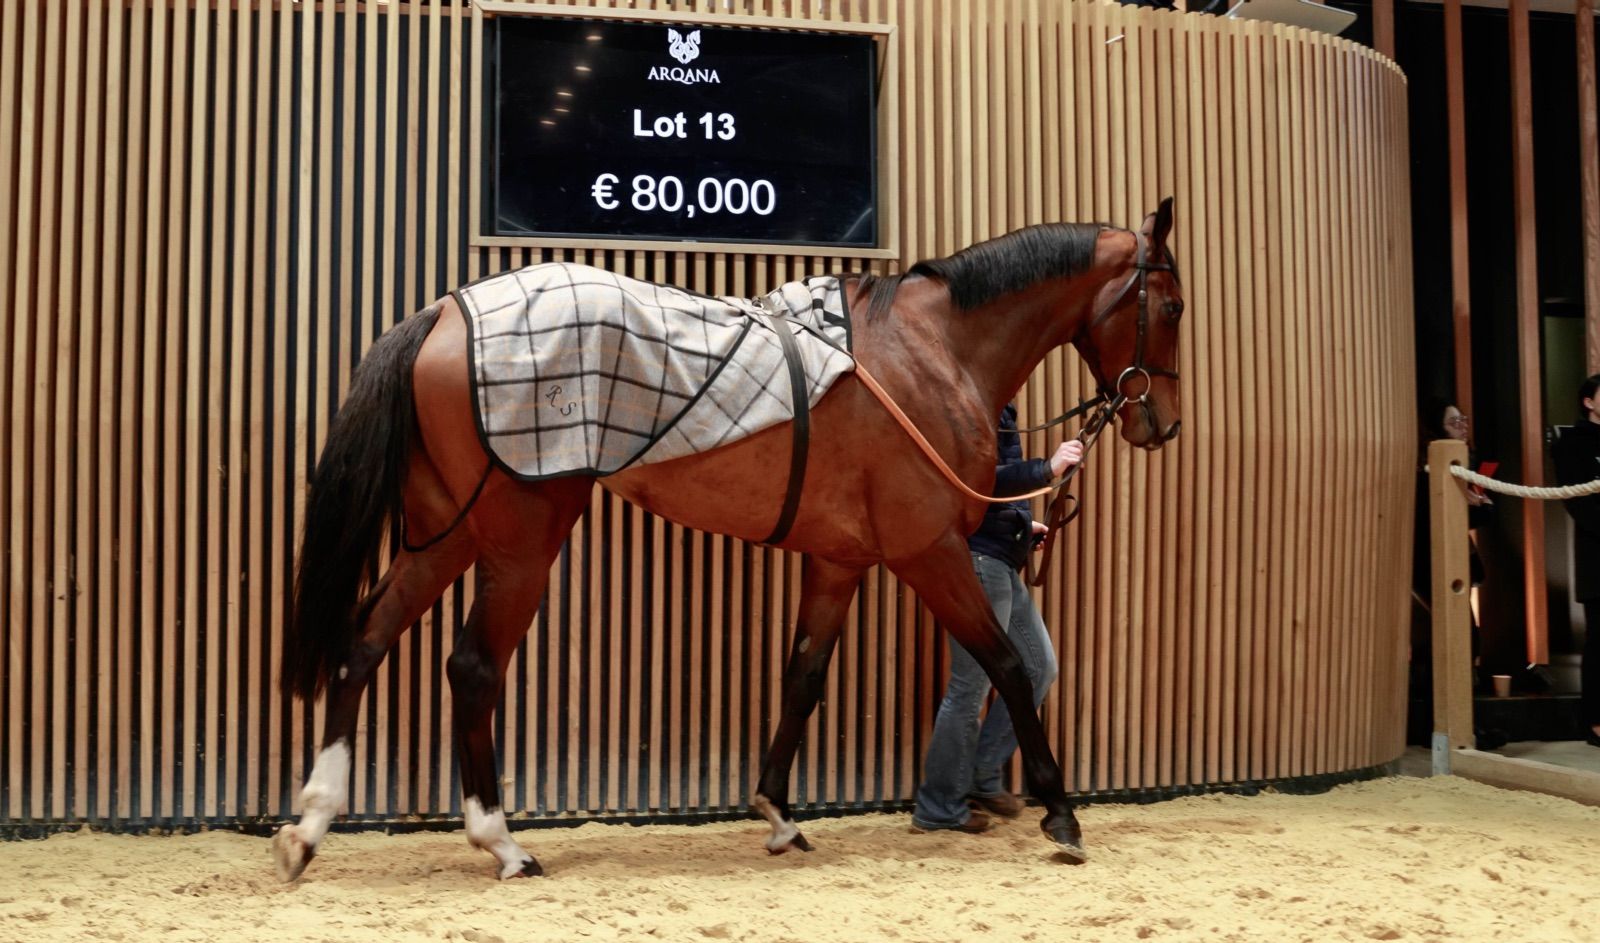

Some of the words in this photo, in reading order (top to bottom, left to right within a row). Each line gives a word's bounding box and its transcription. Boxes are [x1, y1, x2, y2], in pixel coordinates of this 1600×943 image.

[648, 66, 721, 85] ARQANA
[633, 108, 687, 139] Lot
[699, 111, 736, 141] 13
[591, 172, 620, 210] €
[631, 174, 776, 219] 80,000
